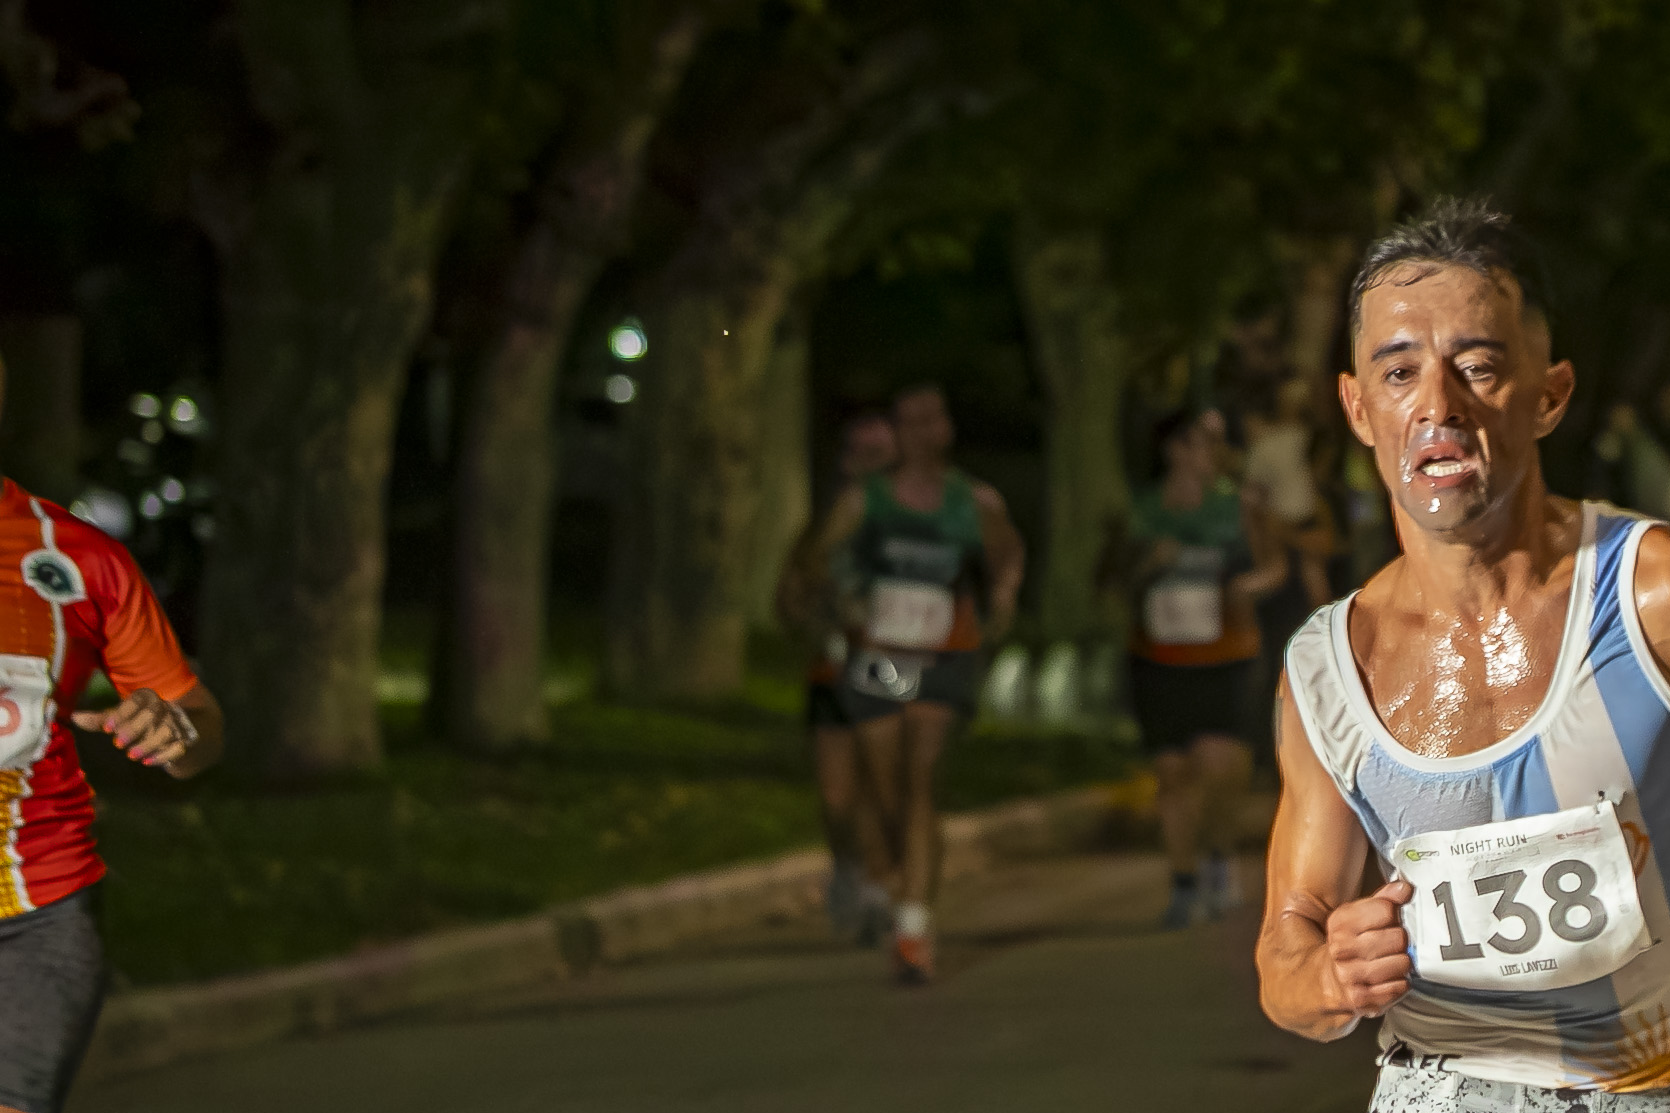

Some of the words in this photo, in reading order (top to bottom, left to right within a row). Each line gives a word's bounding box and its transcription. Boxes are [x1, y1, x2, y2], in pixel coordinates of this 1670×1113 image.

[1450, 839, 1492, 856] NIGHT
[1497, 833, 1528, 849] RUN
[1432, 859, 1608, 961] 138
